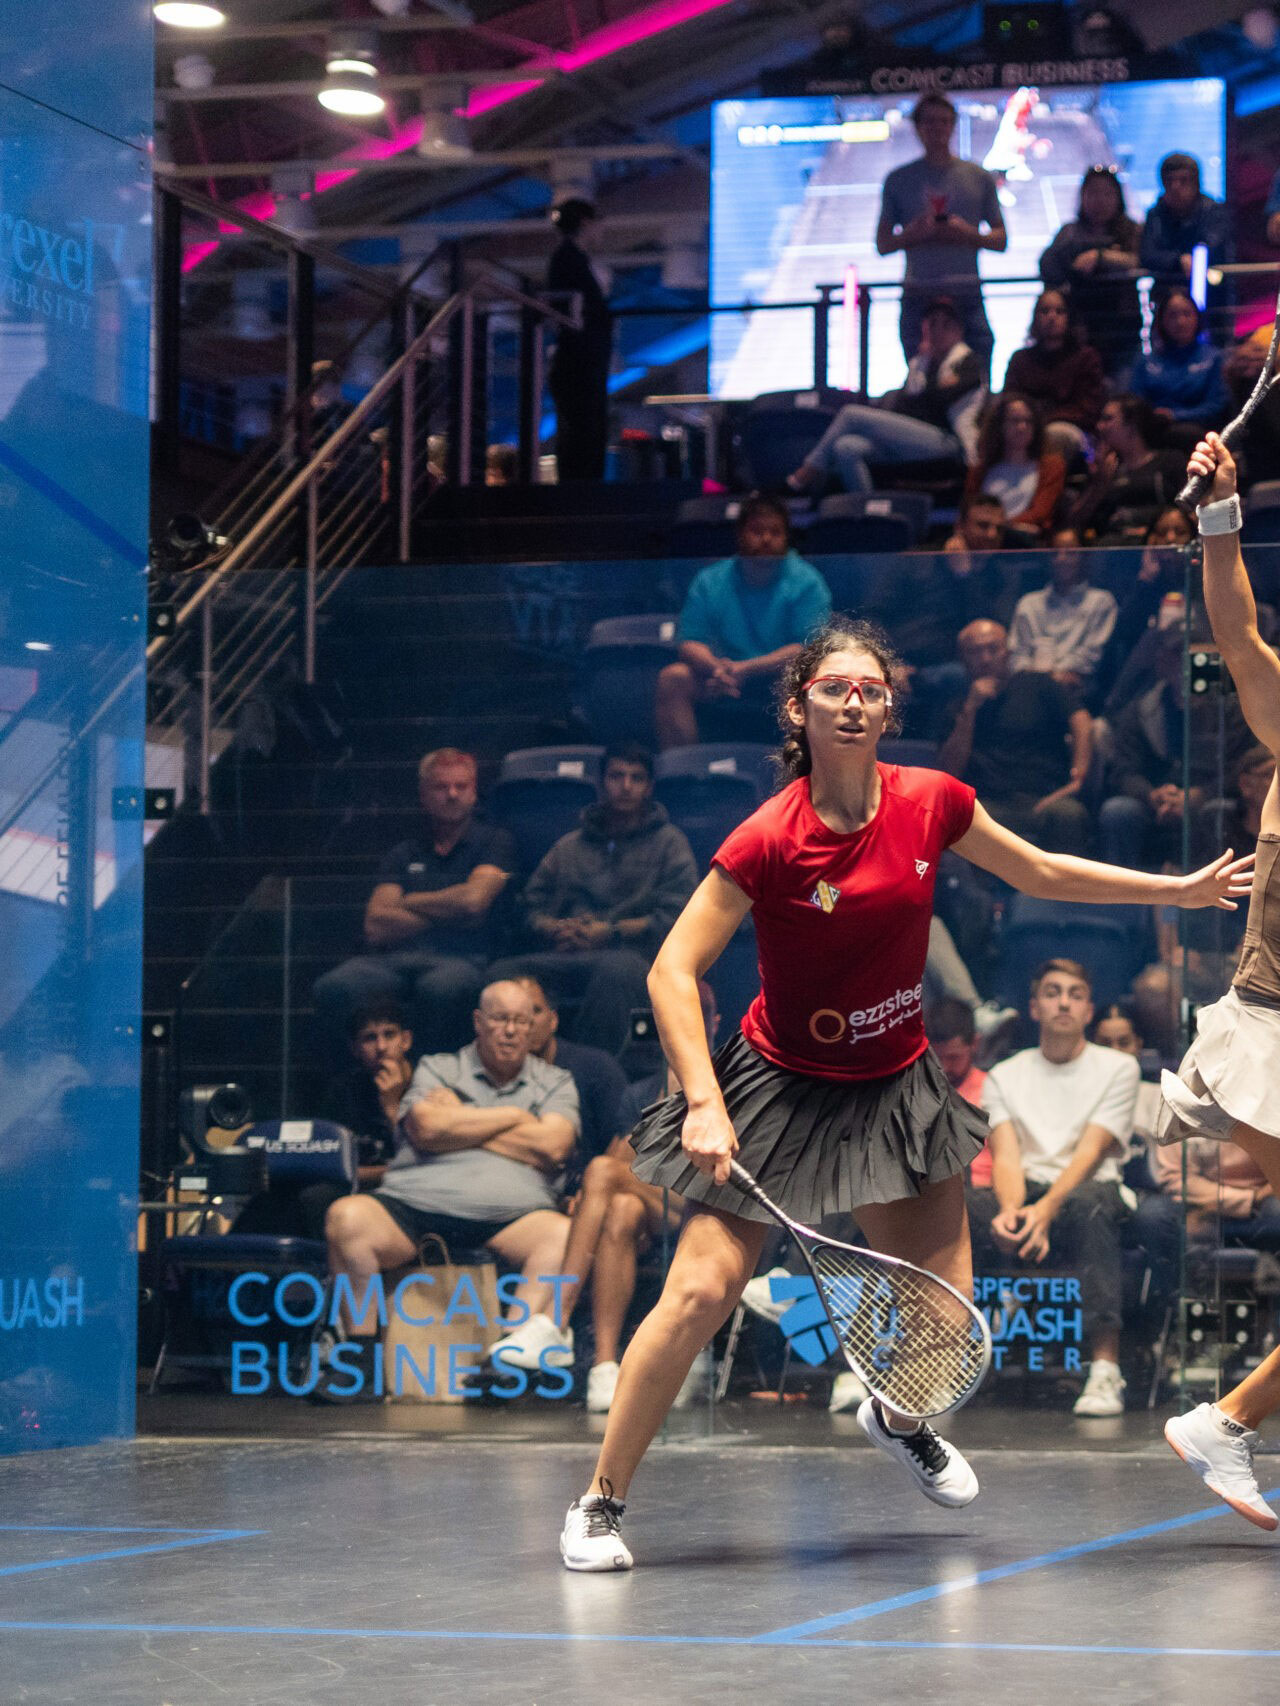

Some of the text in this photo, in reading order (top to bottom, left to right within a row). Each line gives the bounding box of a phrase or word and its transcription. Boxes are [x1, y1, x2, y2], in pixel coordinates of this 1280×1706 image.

[870, 64, 995, 91] COMCAST
[1002, 57, 1130, 86] BUSINESS
[228, 1272, 579, 1327] COMCAST
[231, 1341, 574, 1399] BUSINESS
[1222, 1418, 1245, 1434] 305
